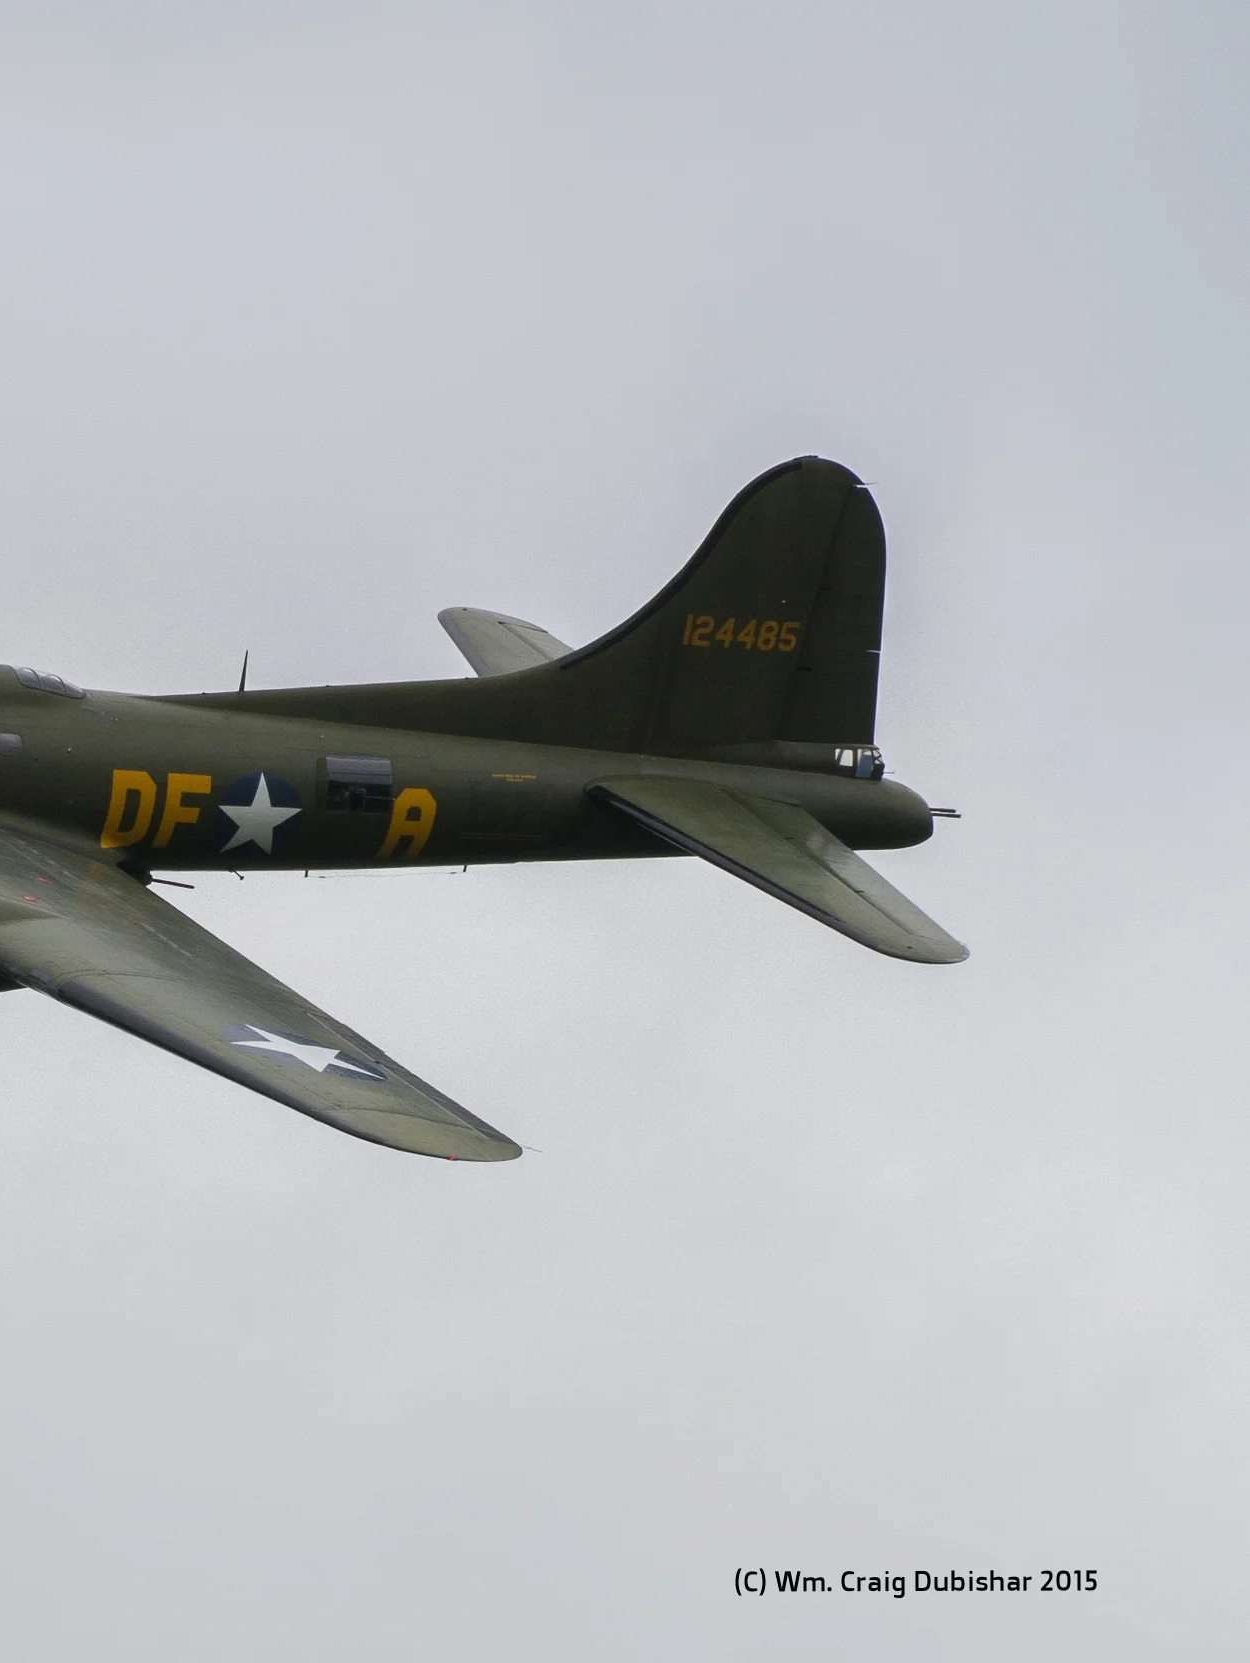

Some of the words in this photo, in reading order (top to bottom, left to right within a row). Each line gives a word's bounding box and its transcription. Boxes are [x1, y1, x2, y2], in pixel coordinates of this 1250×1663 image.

[682, 614, 801, 651] 124485
[100, 769, 212, 848] DF
[377, 788, 437, 857] A
